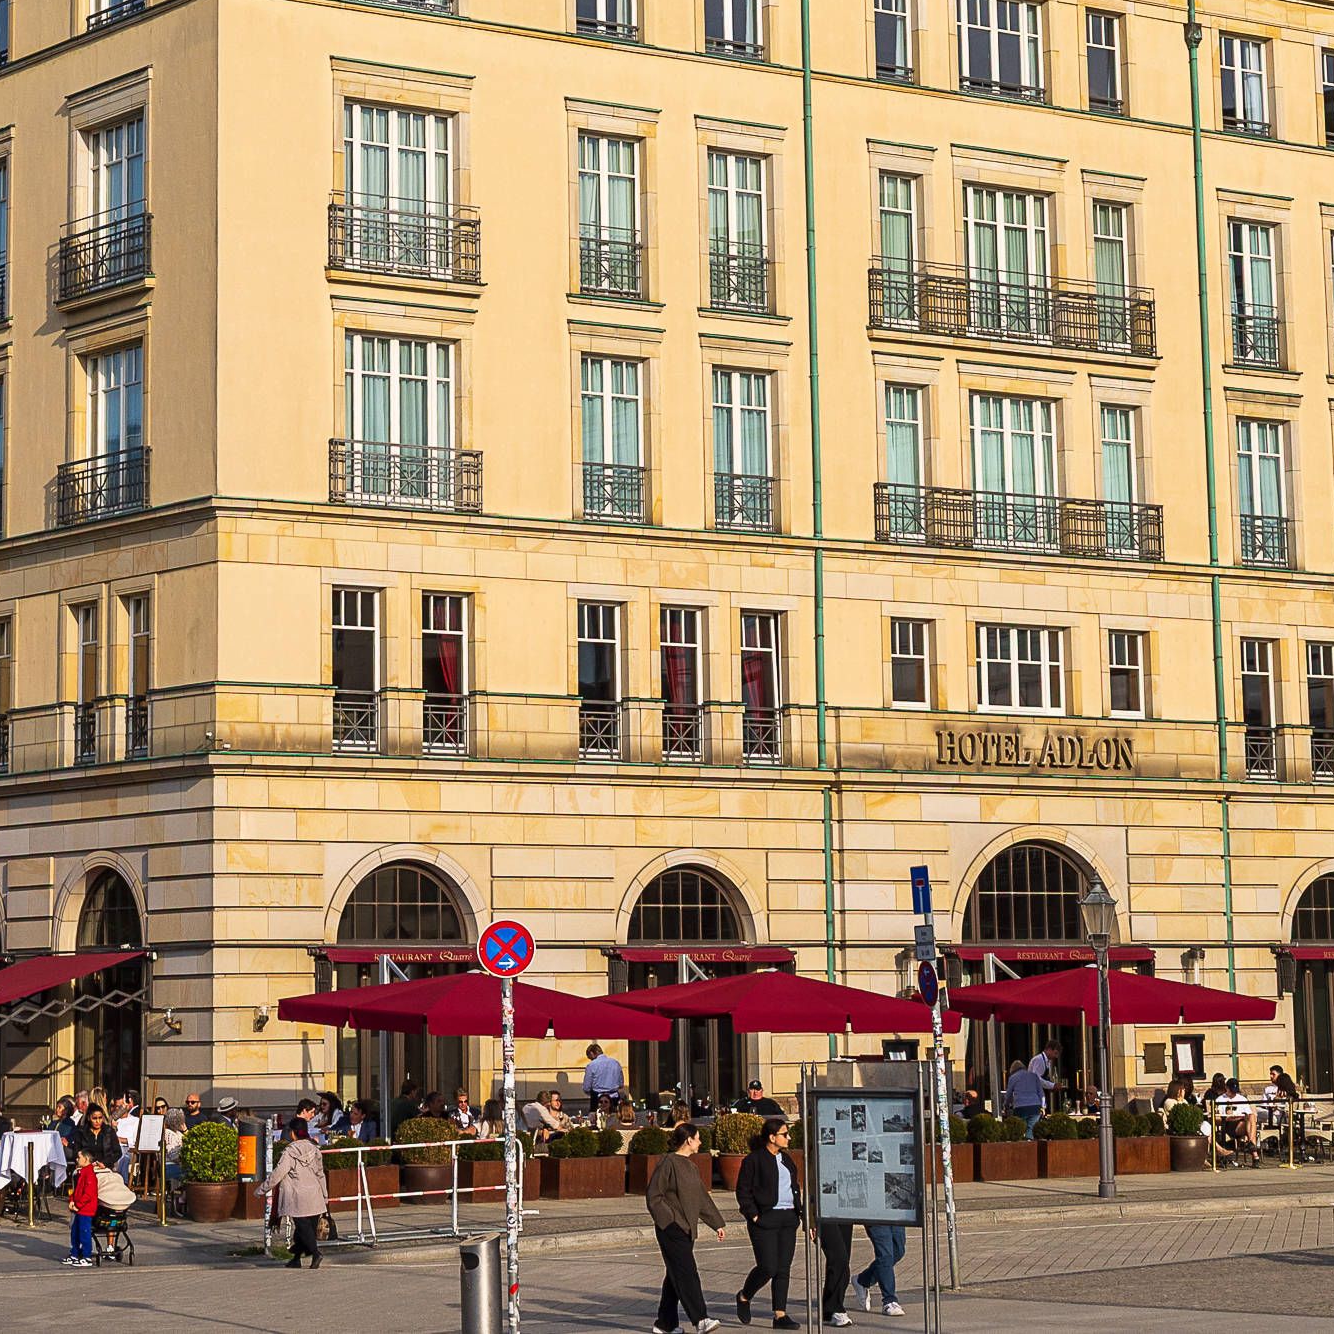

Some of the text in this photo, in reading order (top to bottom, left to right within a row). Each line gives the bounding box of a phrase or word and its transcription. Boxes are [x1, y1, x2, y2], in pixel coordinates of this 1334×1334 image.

[935, 730, 1135, 771] HOTEL ADLON
[374, 953, 433, 961] RTAURANT
[663, 953, 716, 961] RESURANT
[1017, 952, 1064, 960] RESTAURANT
